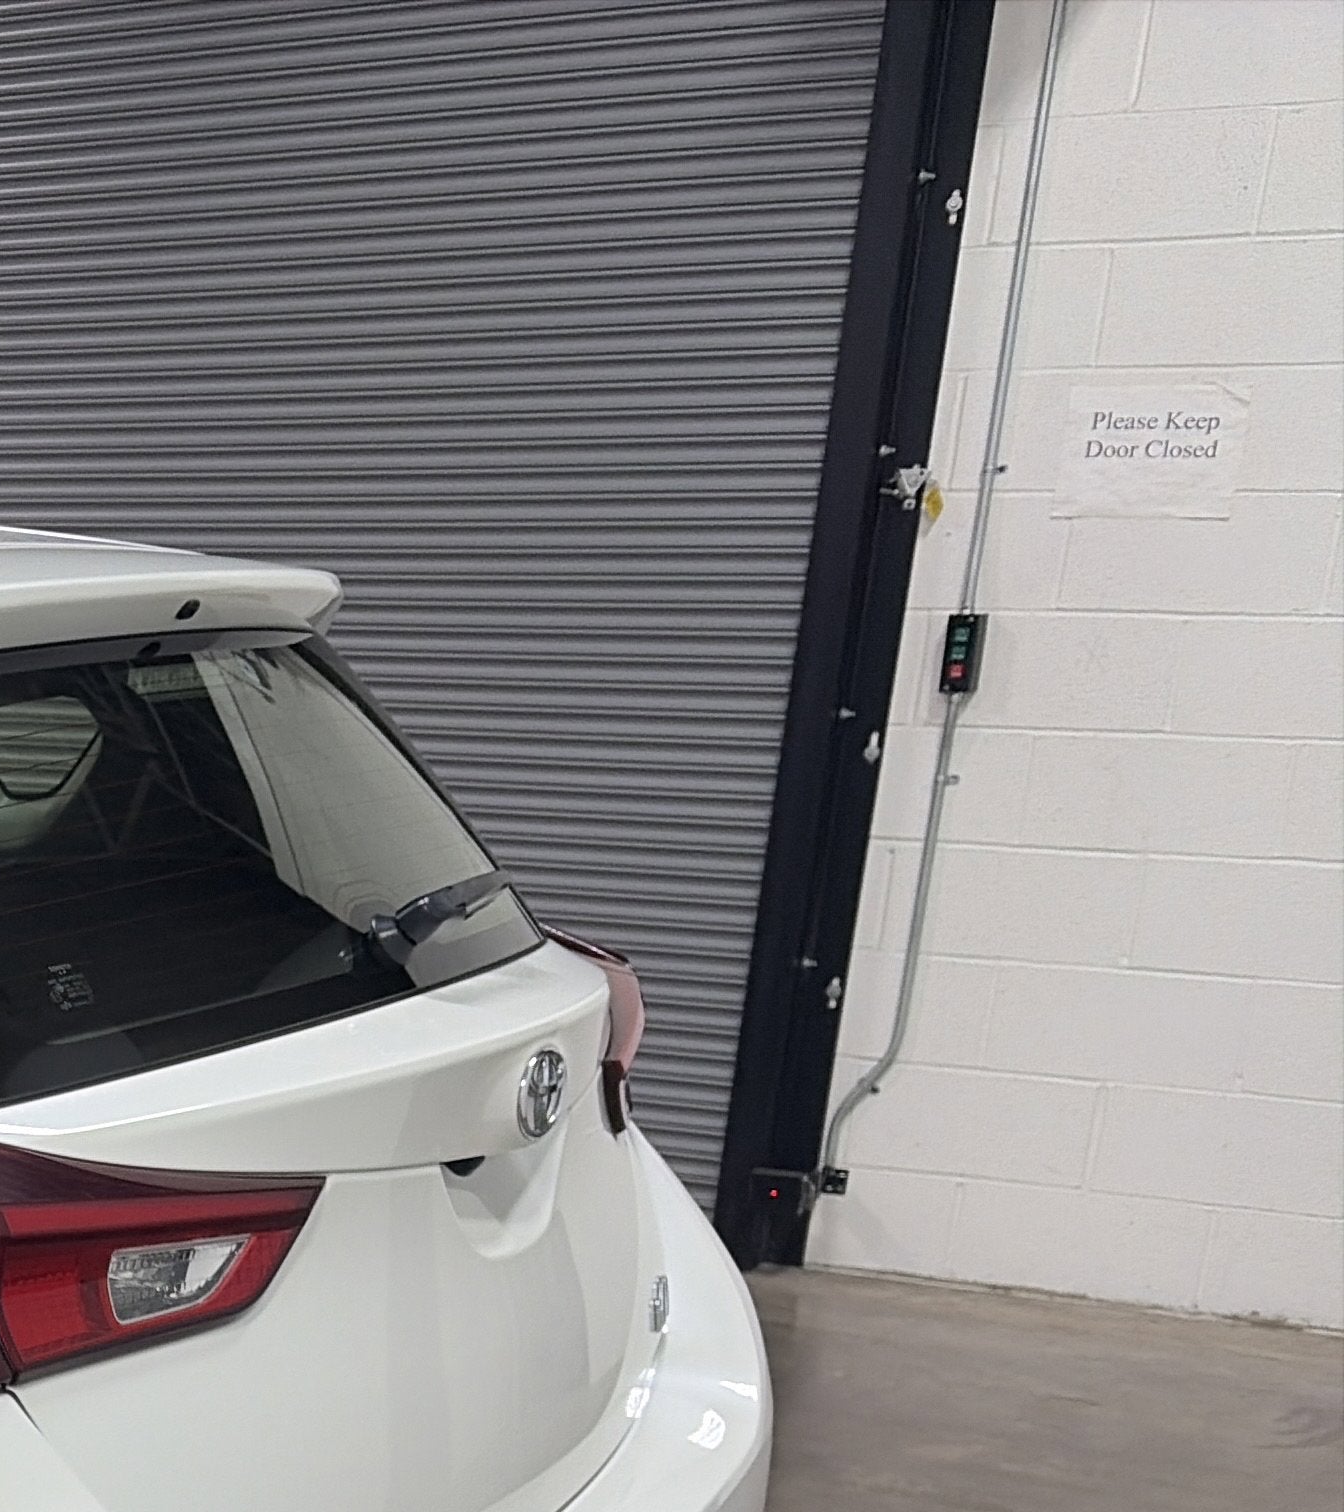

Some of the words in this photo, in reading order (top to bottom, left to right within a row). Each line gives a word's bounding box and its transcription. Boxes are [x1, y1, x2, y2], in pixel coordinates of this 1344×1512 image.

[1091, 411, 1159, 430] Please
[1165, 411, 1221, 435] Keep
[1085, 440, 1139, 458] Door
[1145, 439, 1218, 459] Closed
